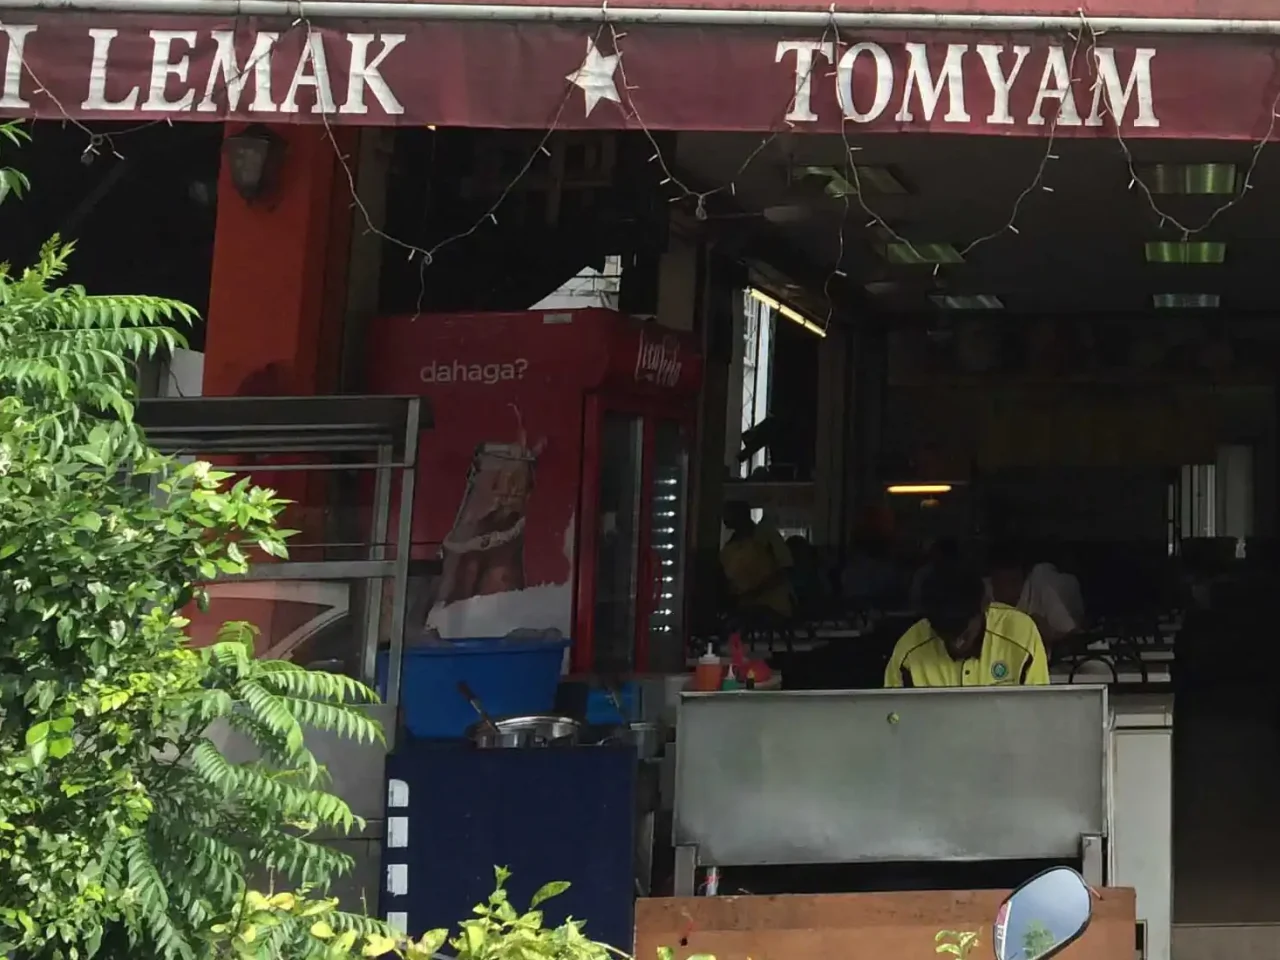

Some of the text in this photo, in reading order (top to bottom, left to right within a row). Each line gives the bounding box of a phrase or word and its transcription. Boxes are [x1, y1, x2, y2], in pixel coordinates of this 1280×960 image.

[81, 28, 406, 115] LEMAK
[775, 41, 1160, 127] TOMYAM
[420, 358, 528, 385] dahaga?
